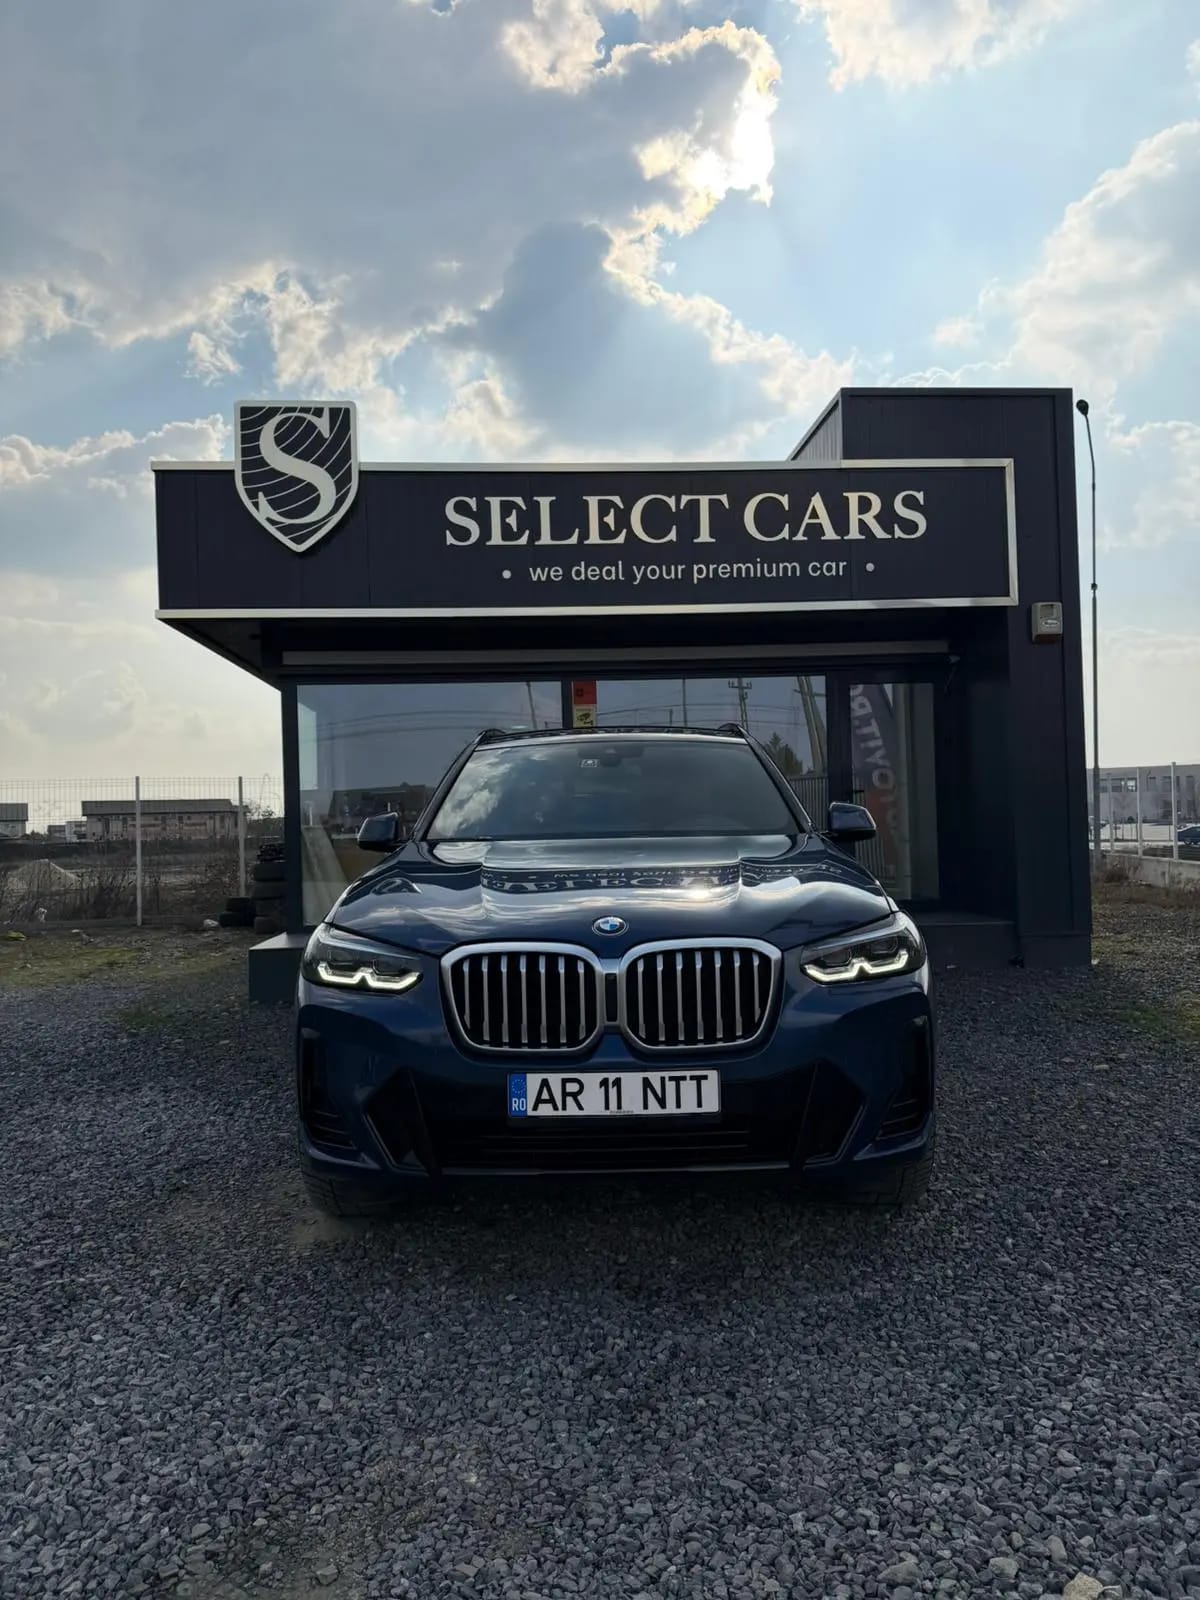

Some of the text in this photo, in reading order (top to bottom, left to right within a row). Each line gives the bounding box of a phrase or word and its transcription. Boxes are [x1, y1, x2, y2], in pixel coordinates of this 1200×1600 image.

[259, 407, 337, 524] S
[444, 490, 928, 546] SELECT CARS
[529, 557, 848, 585] we deal your premium car
[511, 1098, 527, 1112] RO
[531, 1074, 709, 1112] AR 11 NTT
